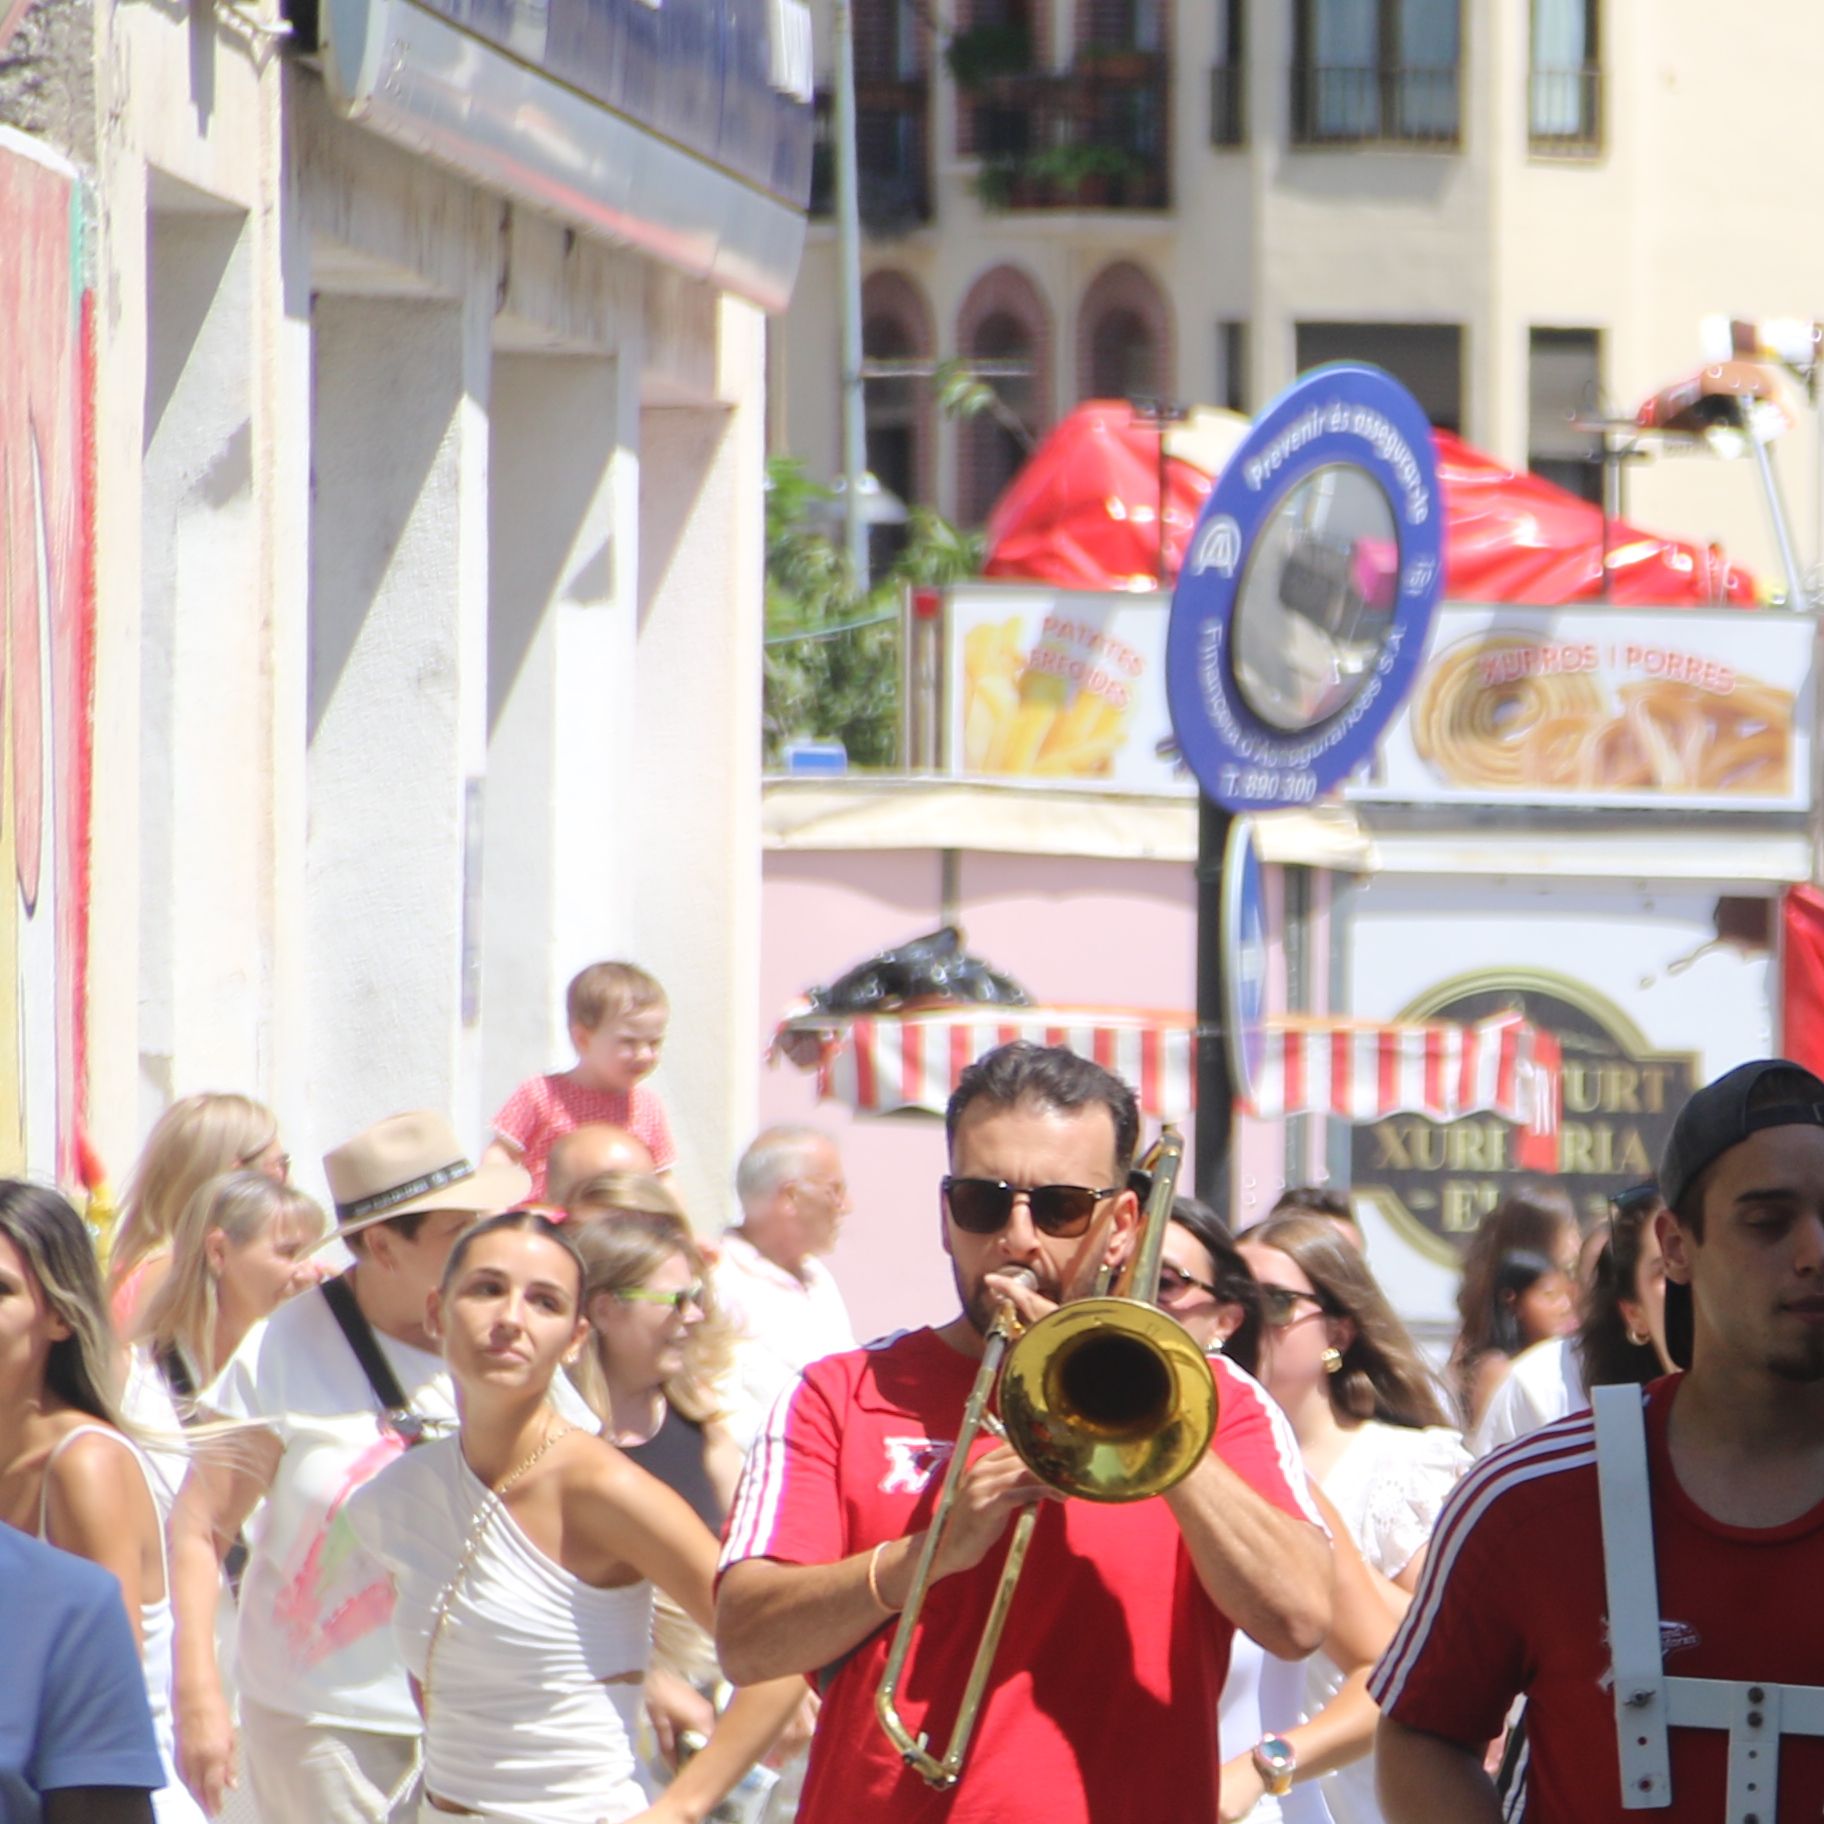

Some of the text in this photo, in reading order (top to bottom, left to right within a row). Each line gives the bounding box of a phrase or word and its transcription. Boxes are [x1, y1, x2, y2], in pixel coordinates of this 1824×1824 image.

[1247, 407, 1325, 491] Prevenir
[1625, 645, 1738, 695] PORRES
[1245, 771, 1279, 799] 890
[1283, 771, 1318, 799] 300
